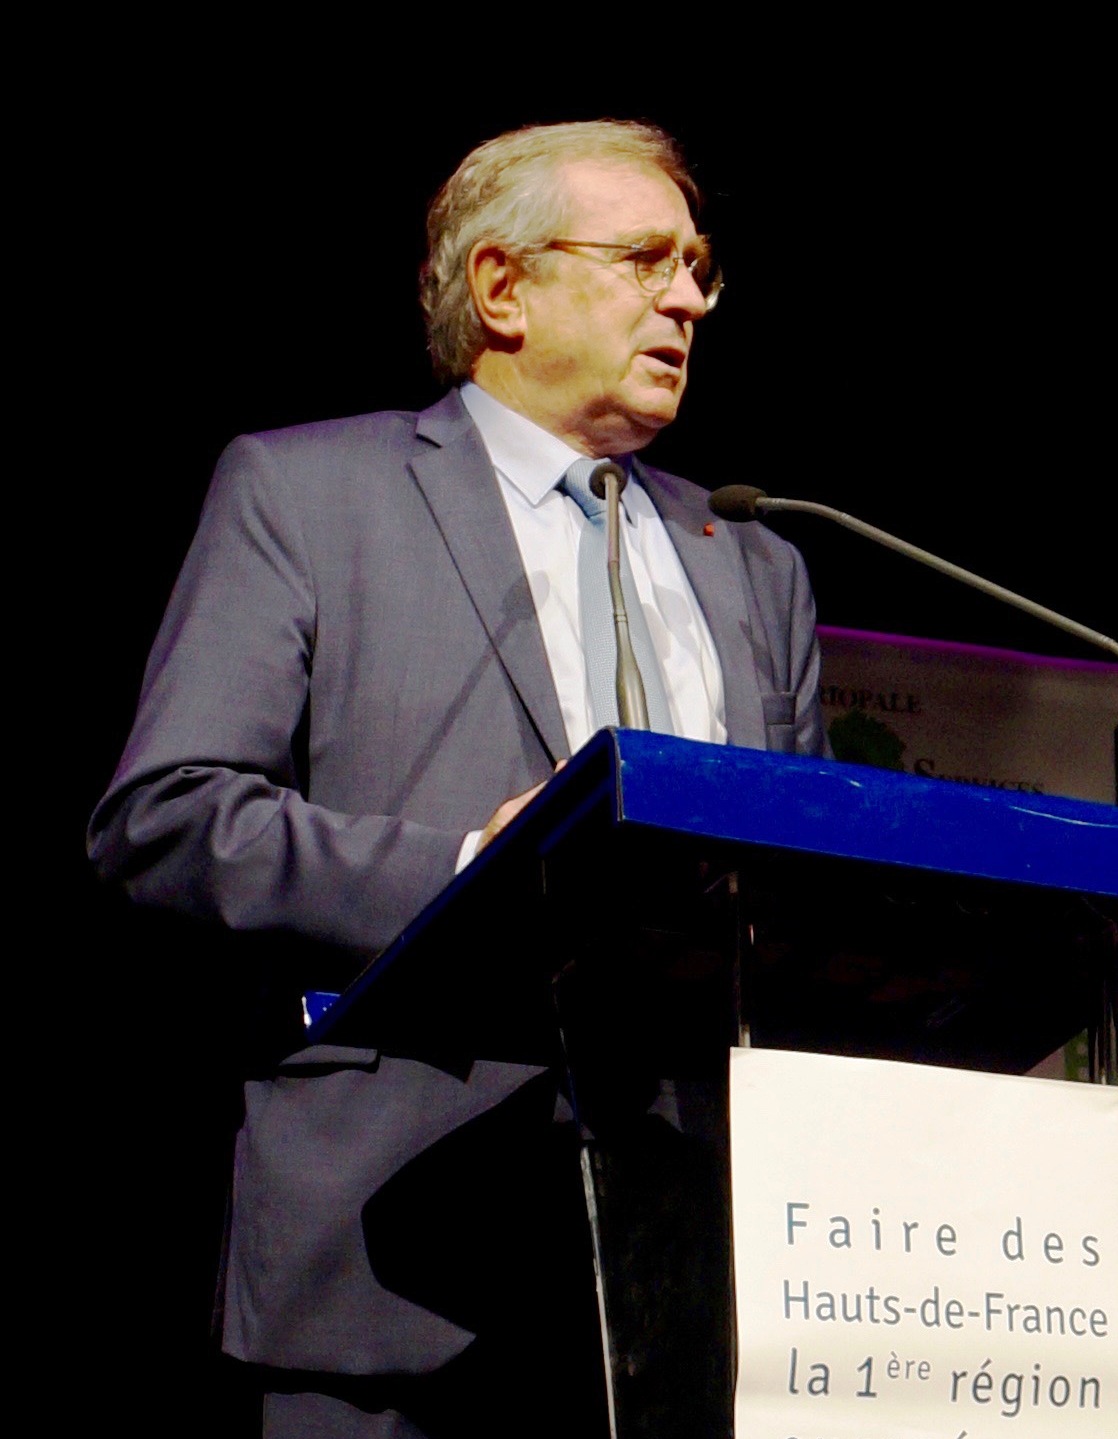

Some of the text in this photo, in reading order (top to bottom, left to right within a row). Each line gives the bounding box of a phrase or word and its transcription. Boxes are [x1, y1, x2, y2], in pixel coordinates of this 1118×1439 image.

[786, 1201, 1101, 1267] Faire des
[782, 1279, 1109, 1337] Hauts-de-France
[787, 1346, 1101, 1418] la 1ère région
